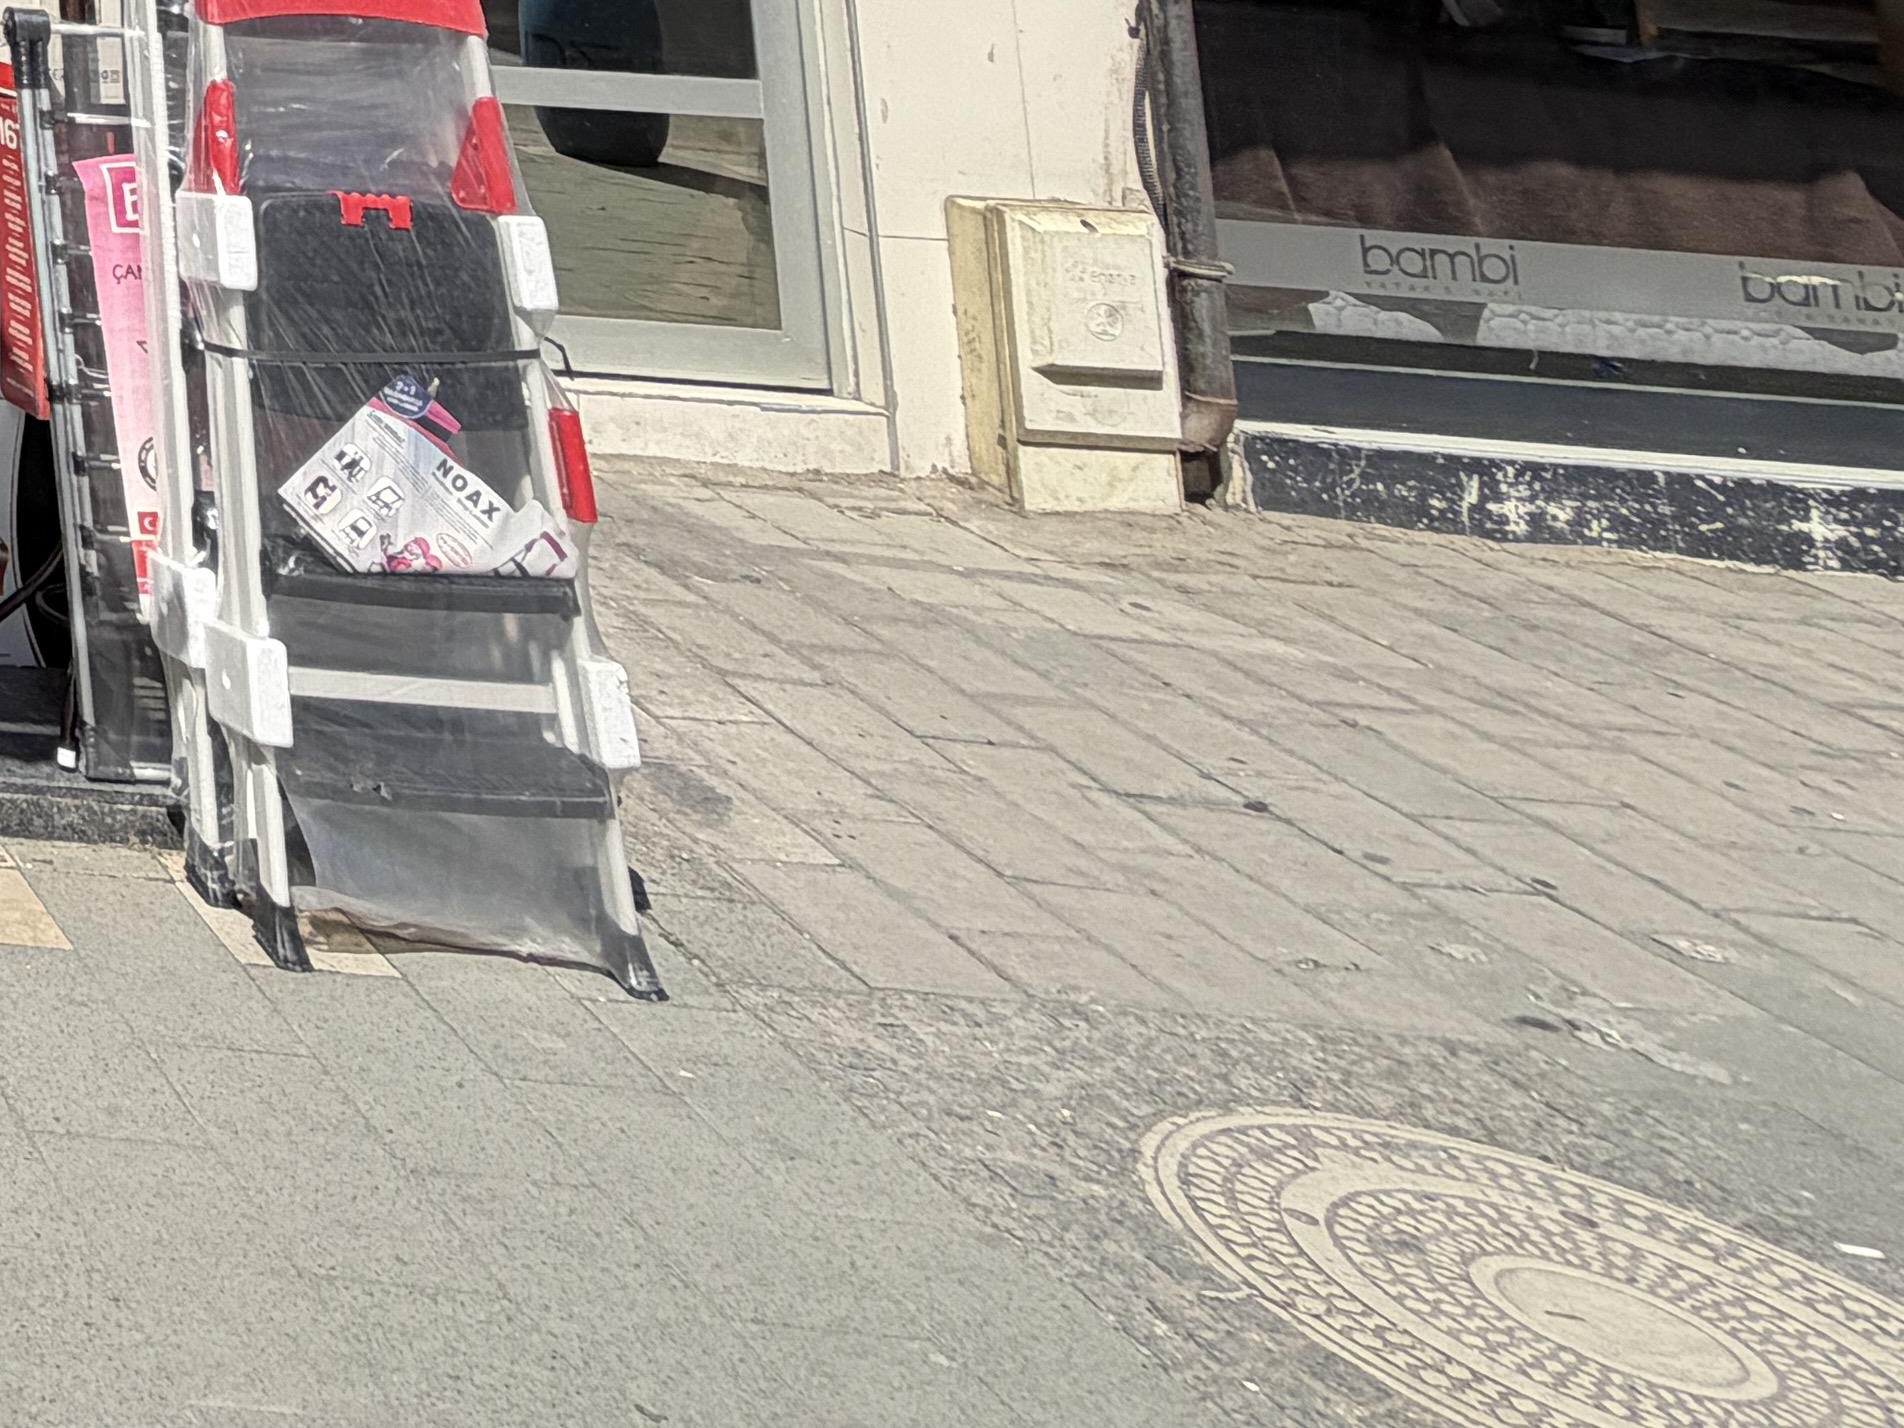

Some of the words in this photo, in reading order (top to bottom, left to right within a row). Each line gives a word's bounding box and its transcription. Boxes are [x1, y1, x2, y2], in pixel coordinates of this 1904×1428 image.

[1360, 234, 1519, 286] bambi
[1738, 260, 1904, 313] bambi
[436, 457, 501, 523] NOAX
